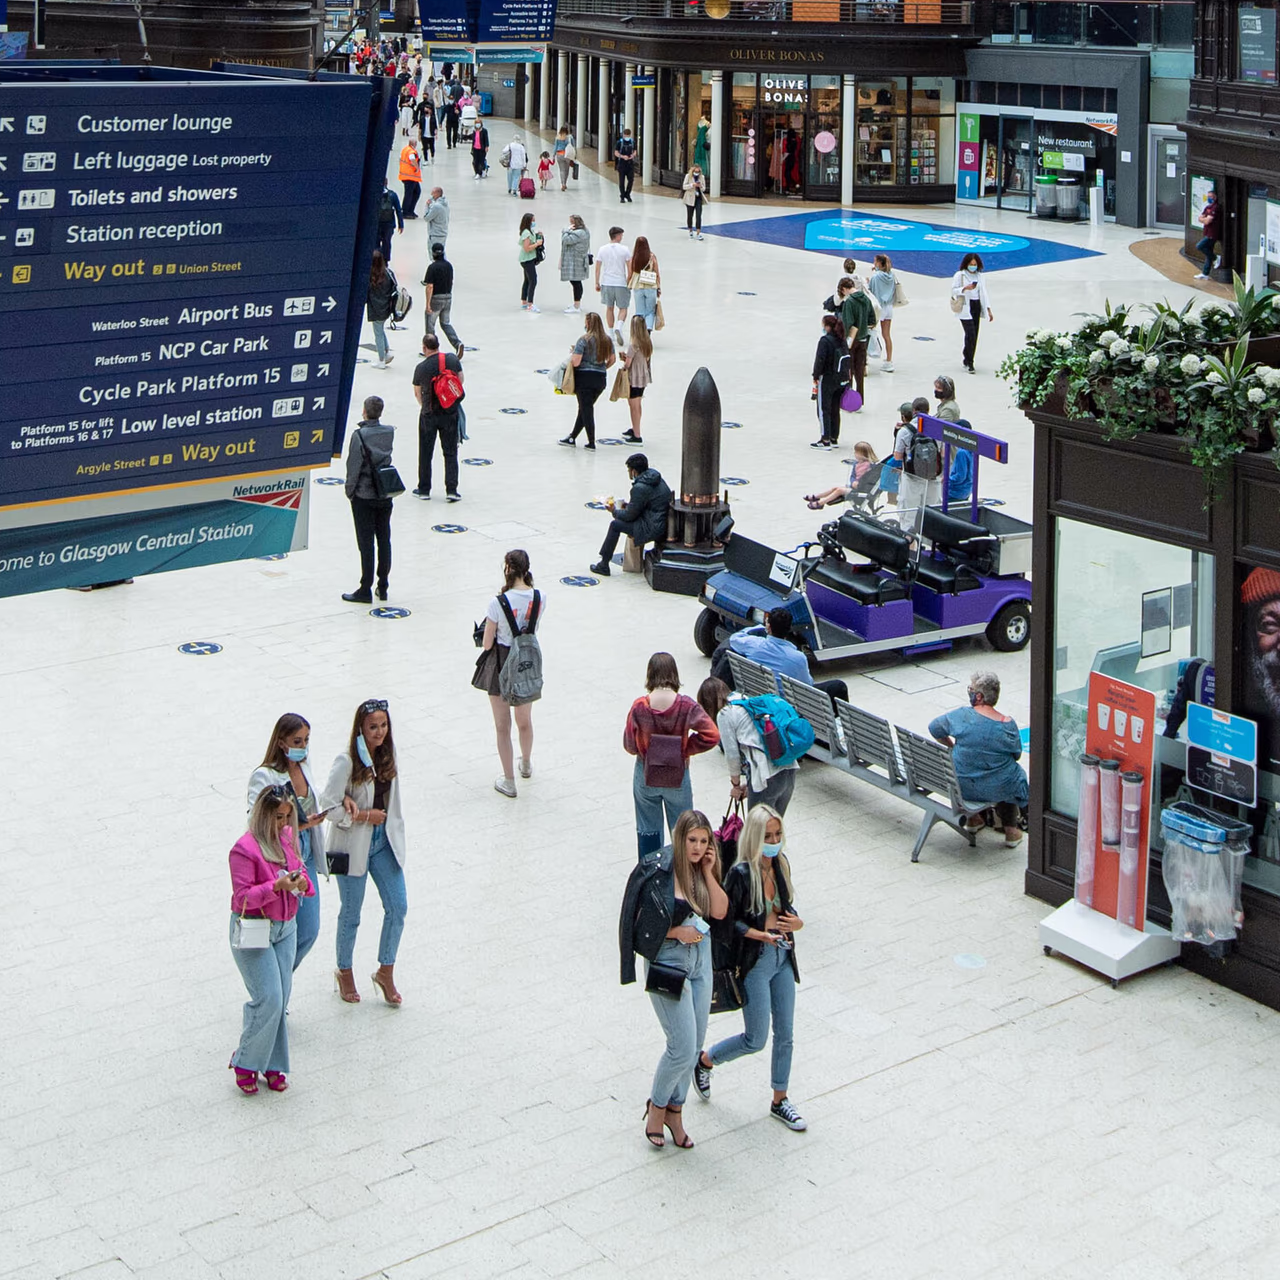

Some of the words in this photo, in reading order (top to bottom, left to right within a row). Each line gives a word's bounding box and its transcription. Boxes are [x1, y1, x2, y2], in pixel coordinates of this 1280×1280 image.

[730, 49, 775, 61] OLIVER
[779, 50, 825, 62] BONAS
[78, 115, 168, 132] Customer
[173, 114, 232, 133] lounge
[1038, 135, 1054, 145] New
[1056, 138, 1093, 148] restaurant
[74, 152, 112, 169] Left
[117, 152, 188, 172] luggage
[193, 154, 218, 166] Lost
[221, 153, 272, 167] property
[68, 189, 125, 206] Toilets
[131, 187, 163, 204] and
[168, 186, 238, 202] showers
[66, 225, 133, 243] Station
[139, 220, 222, 240] reception
[64, 262, 106, 282] Way
[112, 259, 145, 276] out
[179, 263, 208, 274] Union
[211, 262, 241, 272] Street
[91, 319, 137, 332] Waterloo
[139, 316, 169, 328] Street
[177, 304, 239, 325] Airport
[243, 303, 273, 319] Bus
[95, 353, 138, 366] Platform
[141, 352, 151, 362] 15
[159, 343, 195, 360] NCP
[200, 340, 229, 357] Car
[233, 336, 269, 354] Park
[79, 383, 131, 406] Cycle
[136, 377, 176, 398] Park
[181, 370, 258, 392] Platform
[263, 368, 281, 384] 15
[20, 423, 65, 437] Platform
[68, 421, 79, 431] 15
[81, 419, 96, 430] for
[98, 417, 114, 428] lift
[121, 417, 156, 434] Low
[162, 411, 200, 430] level
[205, 406, 262, 424] station
[11, 439, 22, 449] to
[25, 434, 75, 449] Platforms
[77, 432, 88, 442] 16
[91, 430, 100, 440] &
[102, 429, 113, 439] 17
[76, 463, 111, 475] Argyle
[114, 458, 146, 470] Street
[182, 443, 221, 463] Way
[225, 438, 256, 456] out
[232, 477, 306, 498] NetworkRail
[39, 550, 56, 567] to
[60, 537, 132, 566] Glasgow
[136, 530, 194, 553] Central
[197, 521, 254, 543] Station
